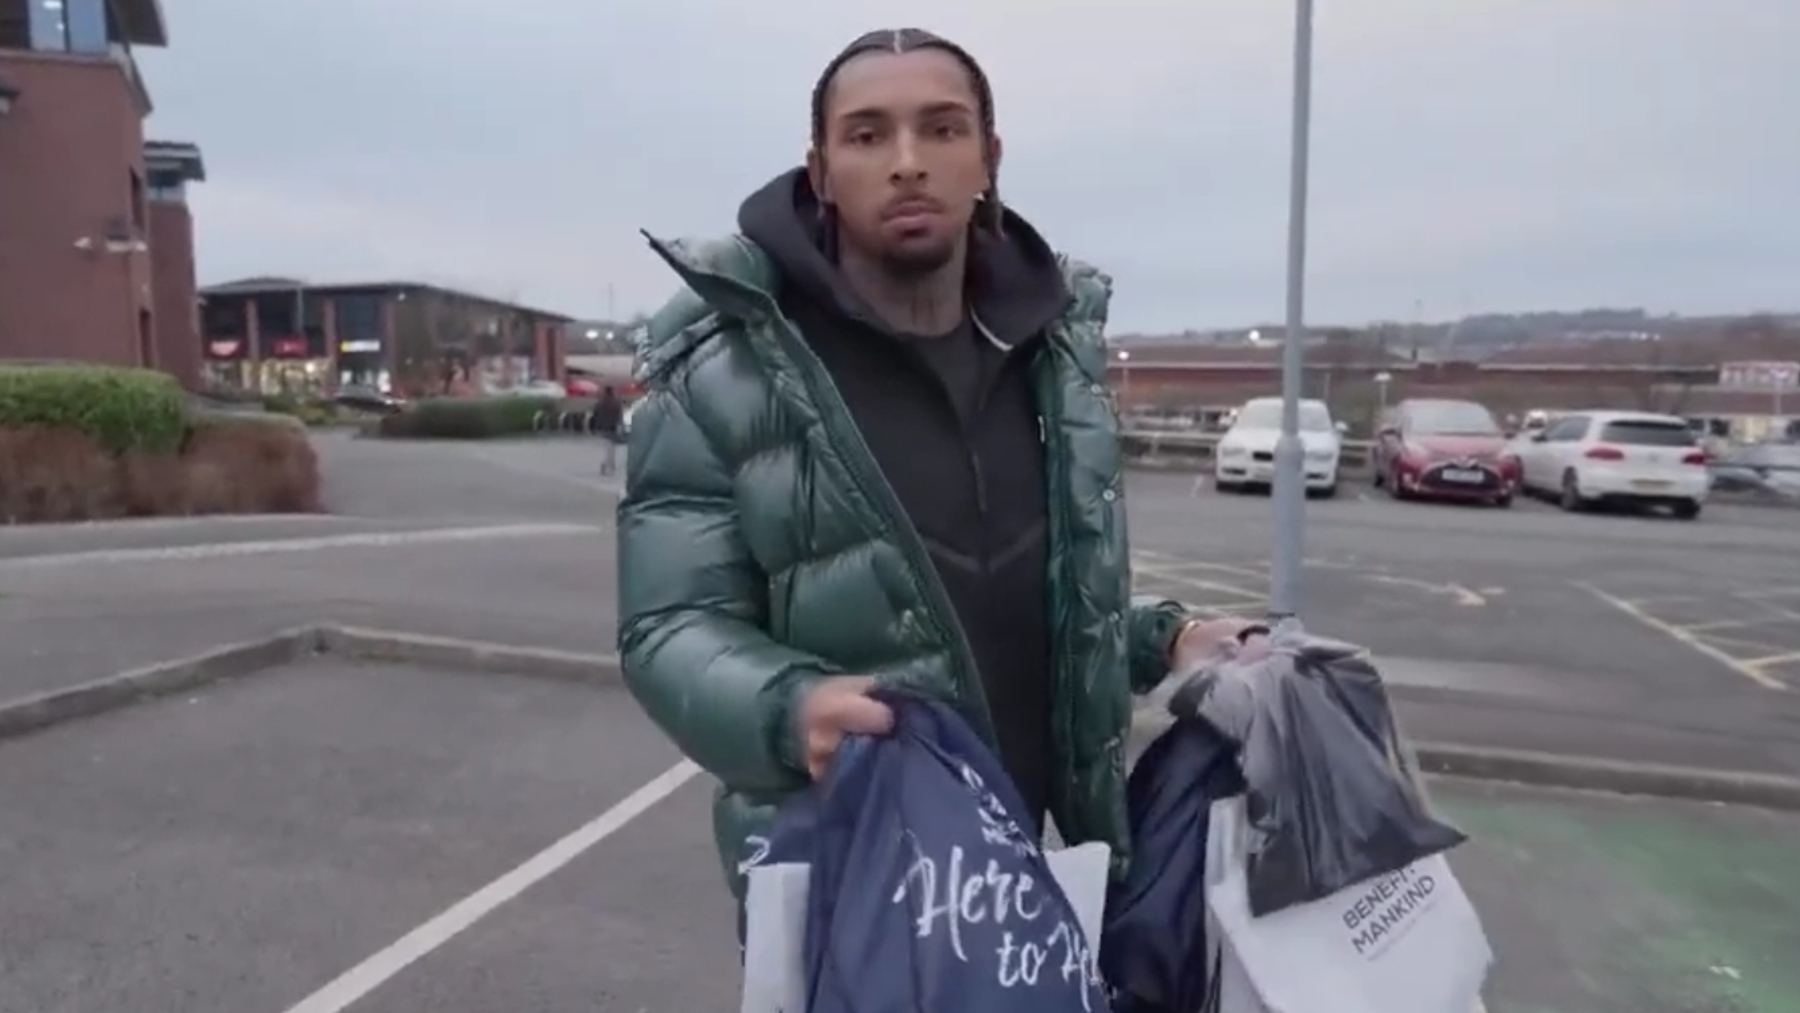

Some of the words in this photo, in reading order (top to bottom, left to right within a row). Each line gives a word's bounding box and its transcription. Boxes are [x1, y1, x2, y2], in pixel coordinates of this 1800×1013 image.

[892, 832, 1042, 963] Here
[1342, 868, 1416, 930] BENEFI
[1351, 874, 1435, 955] MANKIND
[996, 931, 1047, 988] to
